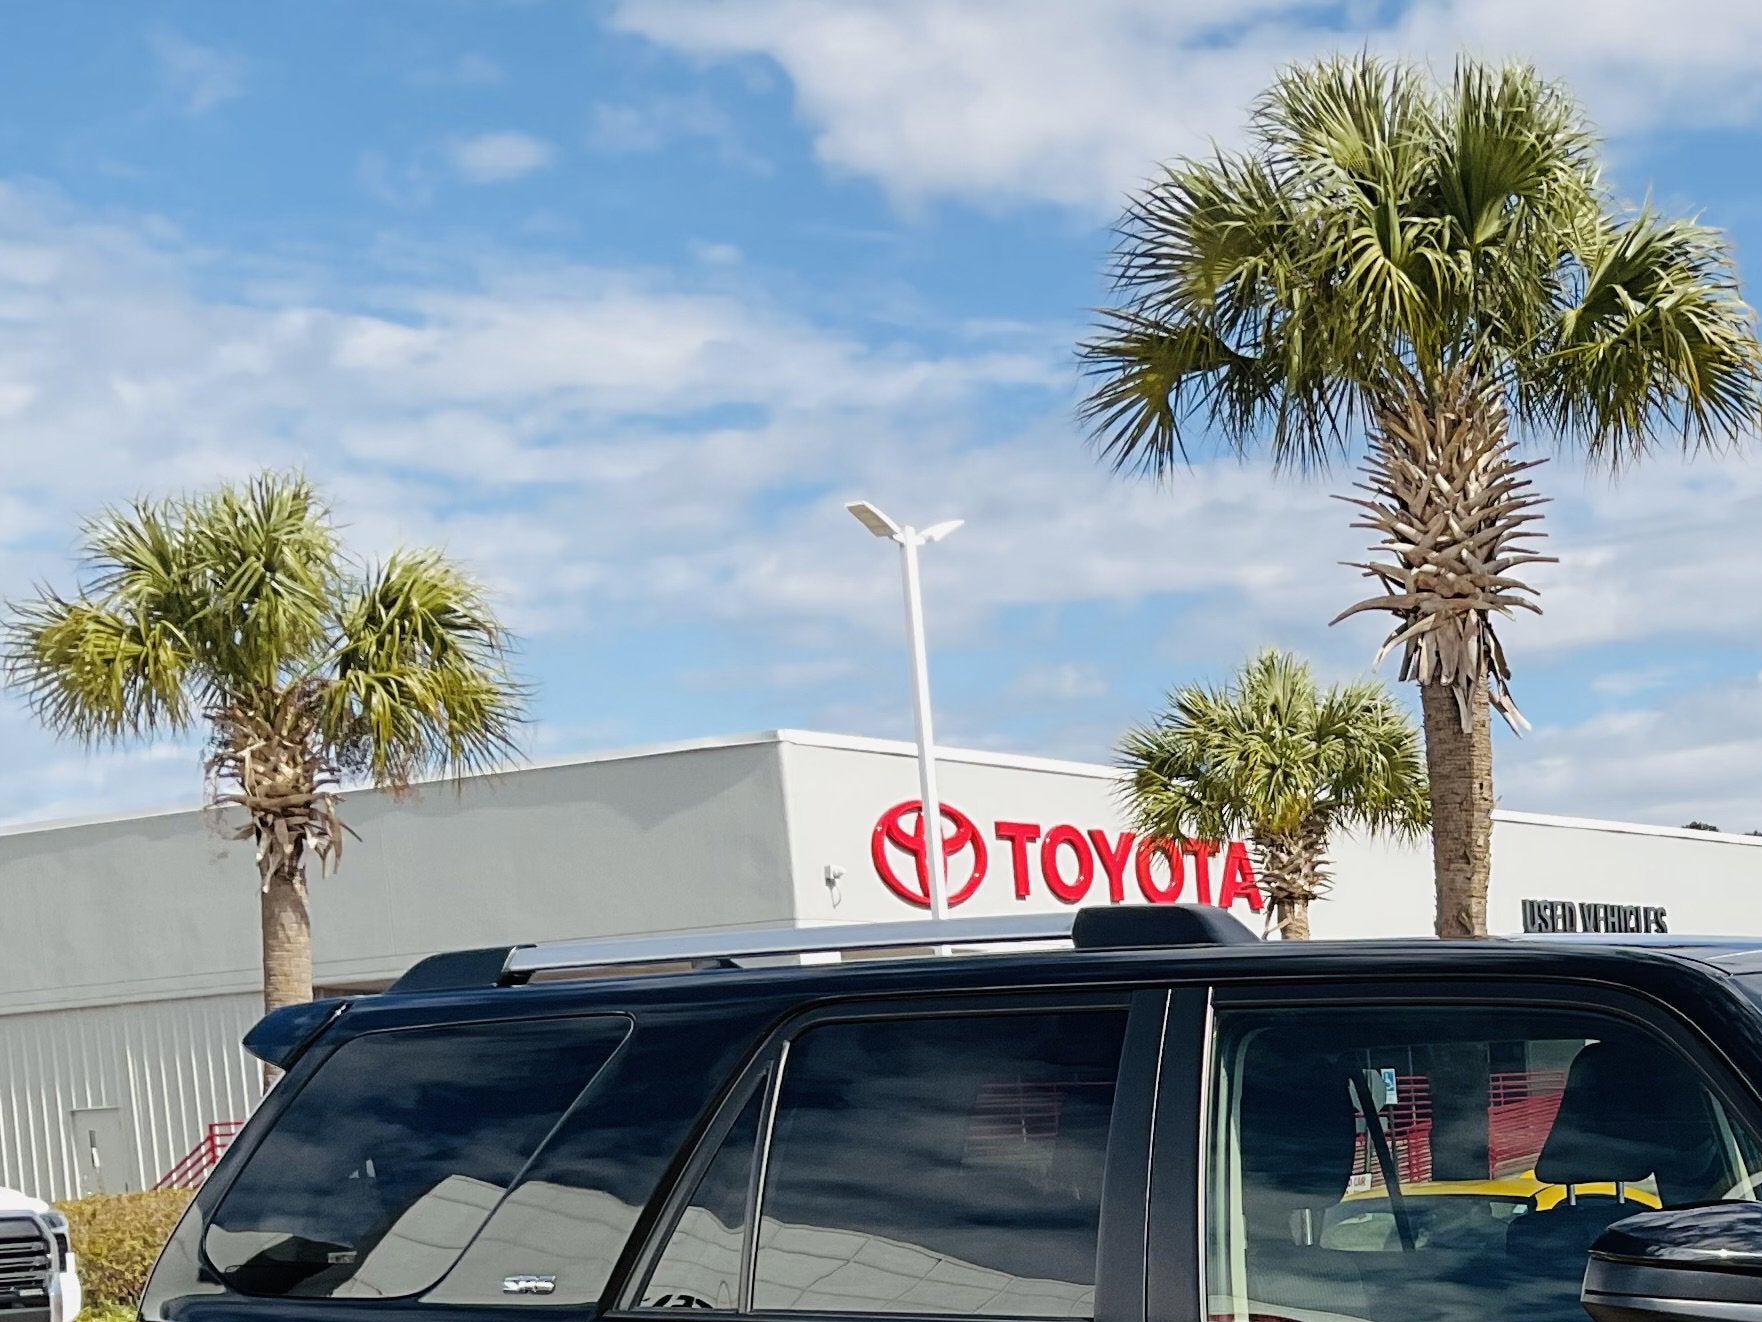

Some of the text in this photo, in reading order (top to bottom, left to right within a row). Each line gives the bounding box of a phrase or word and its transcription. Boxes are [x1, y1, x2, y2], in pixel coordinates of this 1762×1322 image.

[994, 821, 1264, 909] TOYOTA
[1521, 899, 1668, 933] USED VEHICLES
